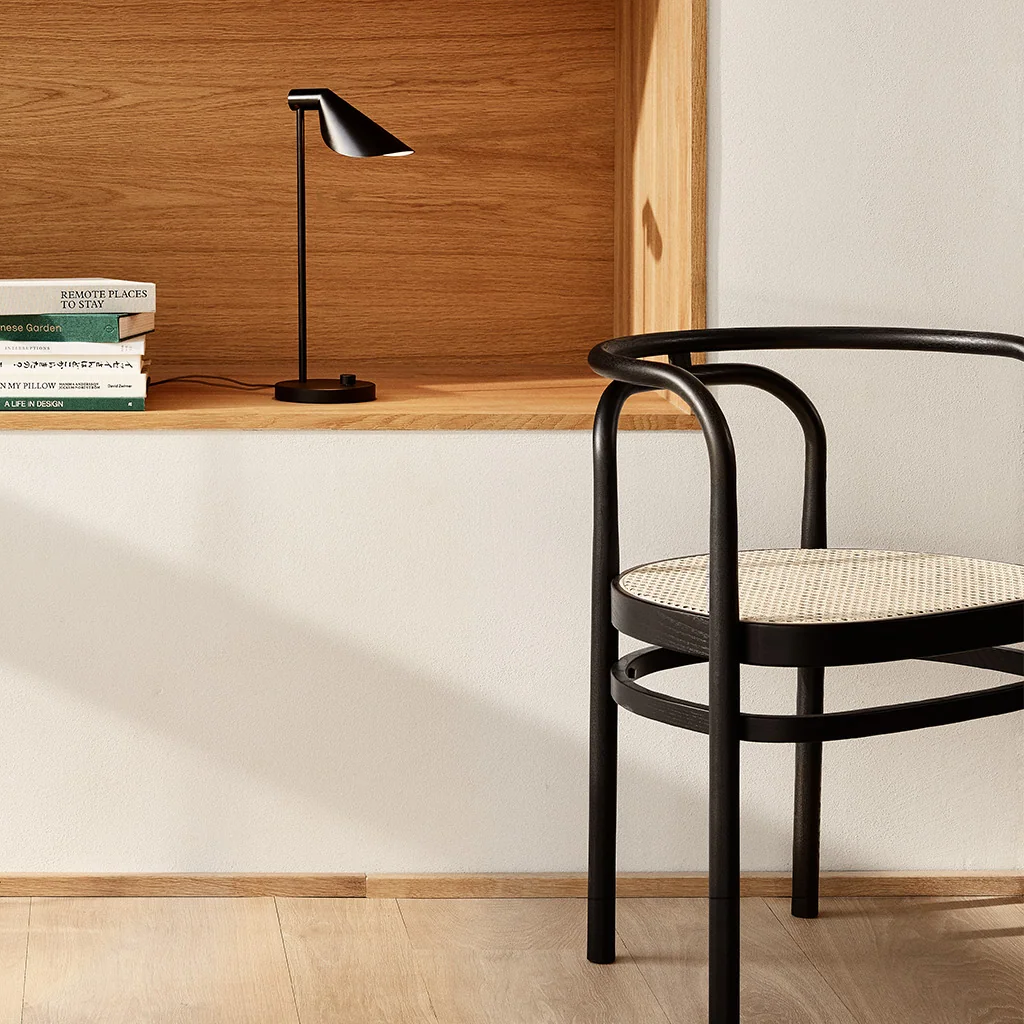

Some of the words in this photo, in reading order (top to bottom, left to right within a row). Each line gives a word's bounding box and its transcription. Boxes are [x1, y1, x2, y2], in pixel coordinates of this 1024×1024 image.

[61, 289, 106, 299] REMOTE
[108, 289, 148, 299] PLACES
[61, 300, 76, 309] TO
[78, 300, 104, 309] STAY
[26, 323, 62, 333] Garden
[8, 381, 22, 390] MY
[23, 381, 56, 390] PILLOW
